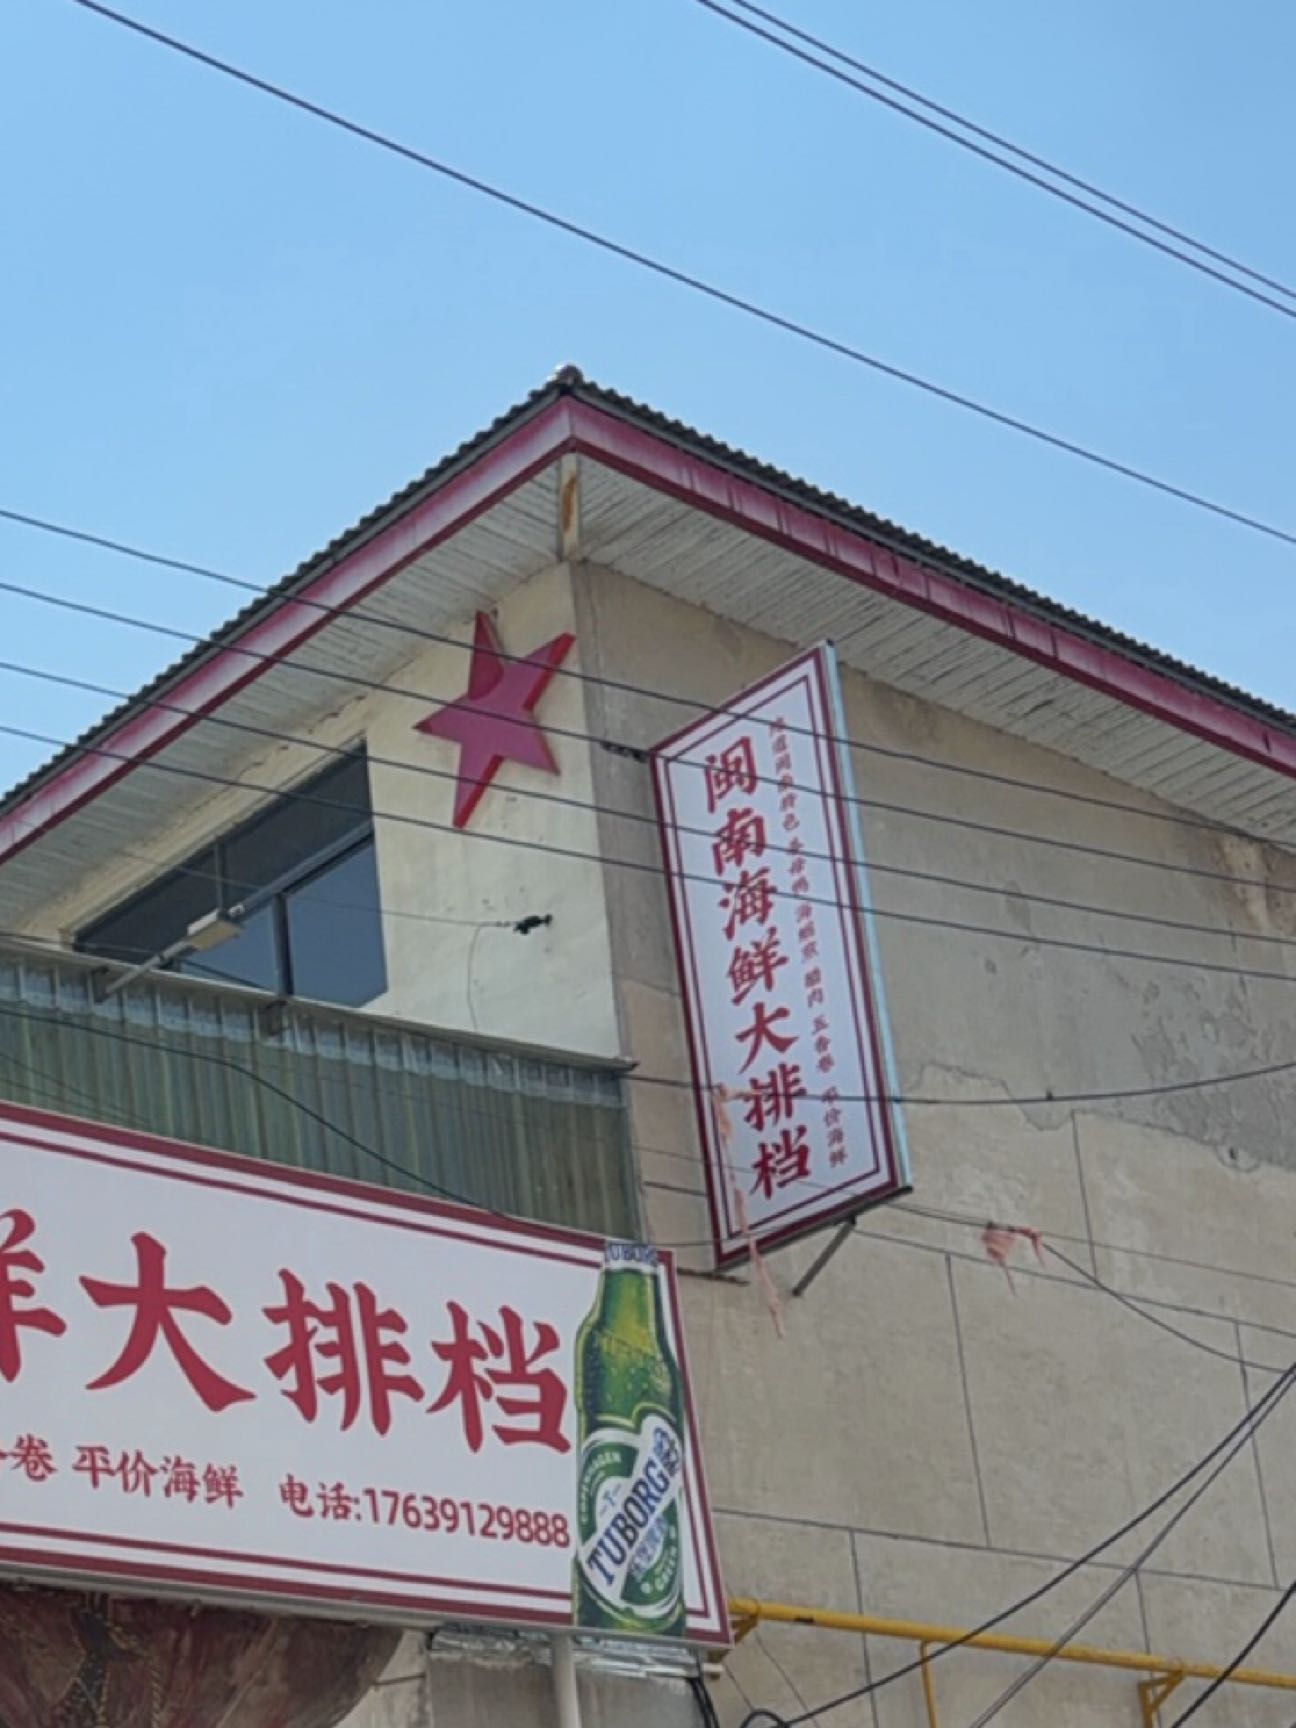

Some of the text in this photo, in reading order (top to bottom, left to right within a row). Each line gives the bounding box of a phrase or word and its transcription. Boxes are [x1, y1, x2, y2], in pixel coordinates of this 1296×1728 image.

[704, 734, 812, 1200] 闽南海鲜大排档
[71, 1445, 245, 1508] 平价海鲜
[587, 1457, 670, 1585] TUBORG
